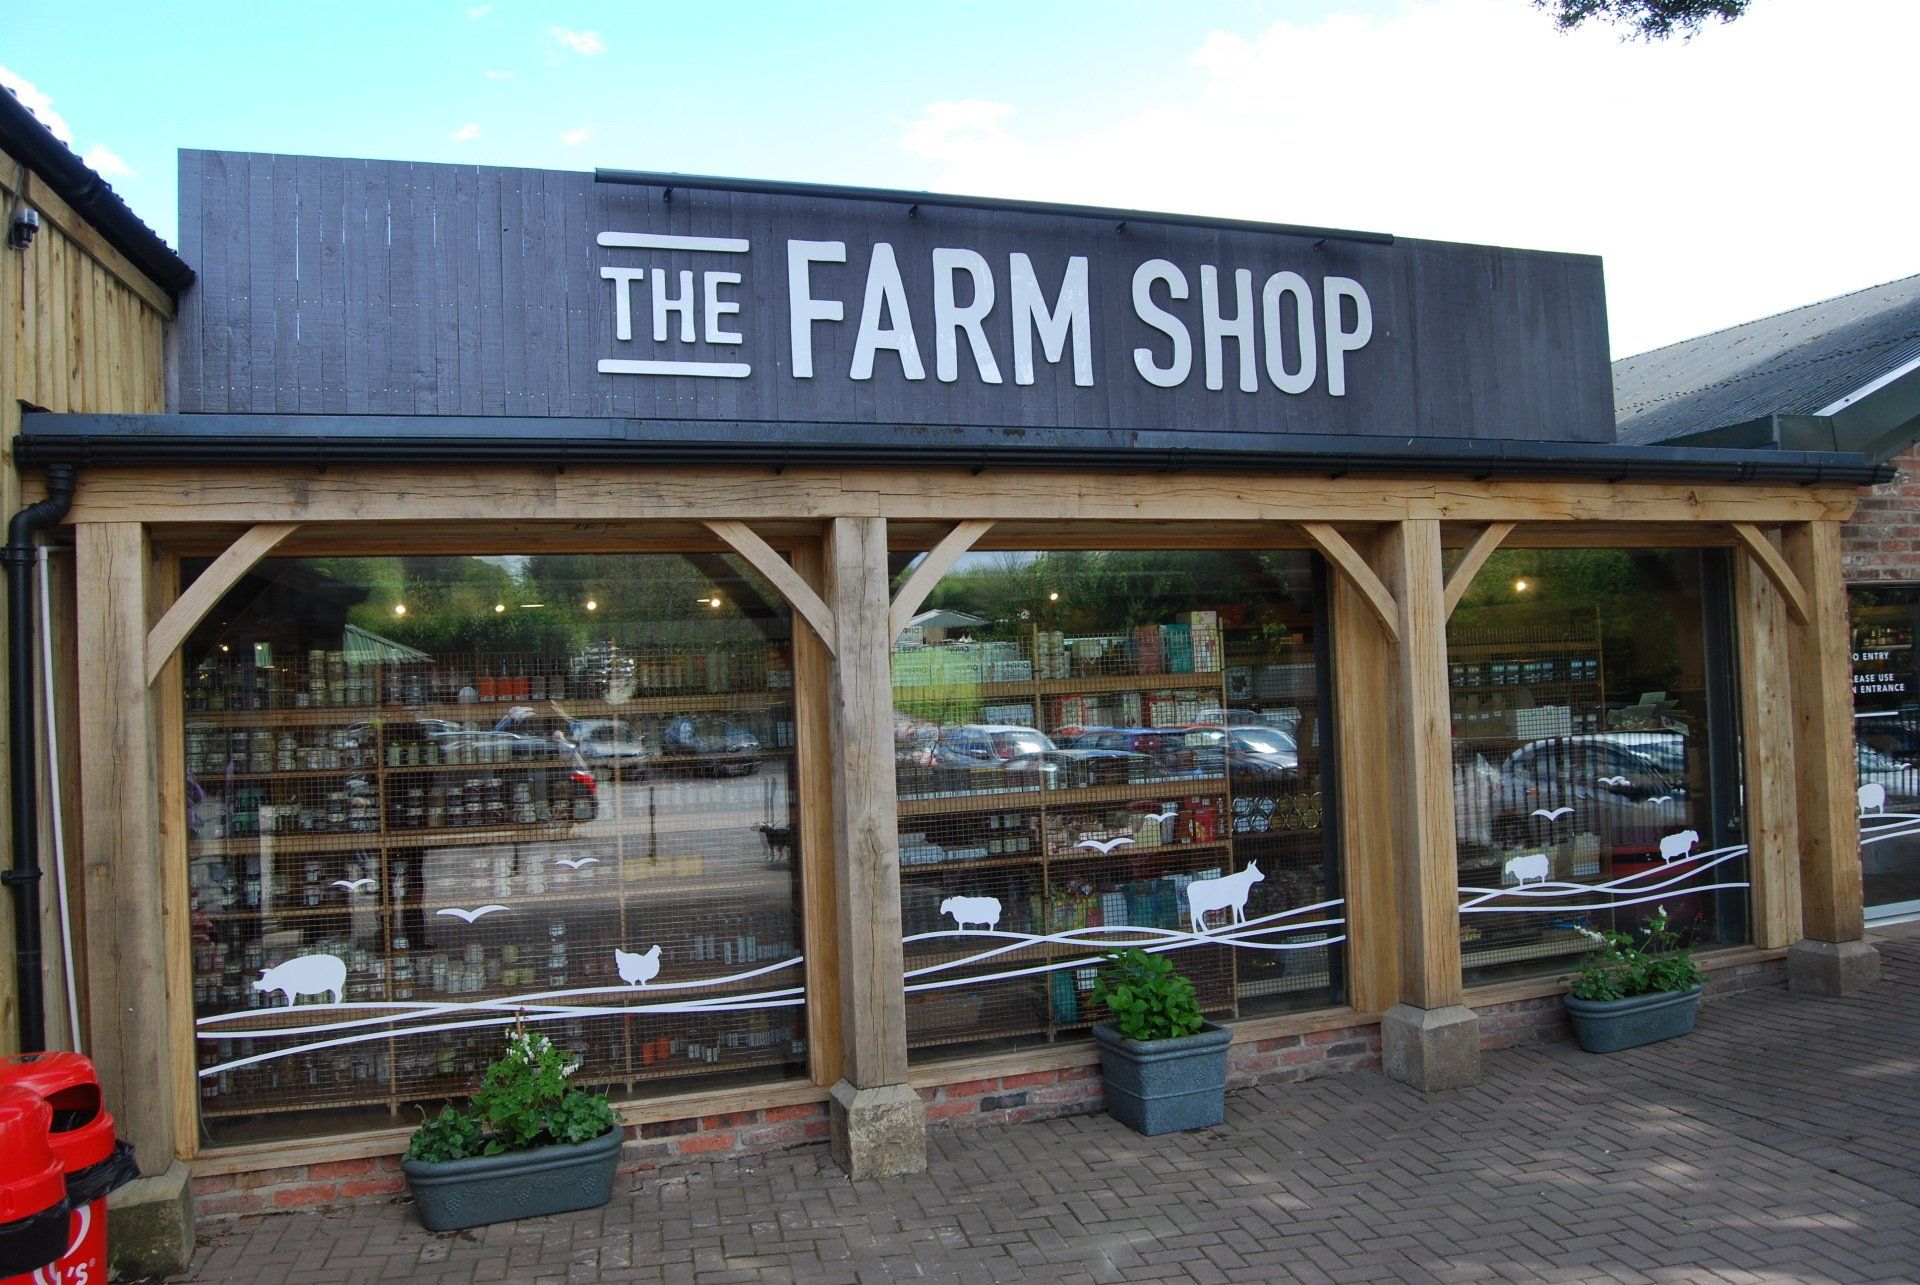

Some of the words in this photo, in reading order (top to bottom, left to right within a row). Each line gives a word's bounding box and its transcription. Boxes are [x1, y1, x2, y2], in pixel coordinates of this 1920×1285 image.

[601, 267, 742, 343] THE
[788, 240, 1093, 386] FARM
[1133, 259, 1372, 395] SHOP
[1863, 652, 1889, 660] ENTRY
[1878, 673, 1894, 682] USE
[1861, 684, 1904, 693] ENTRANCE
